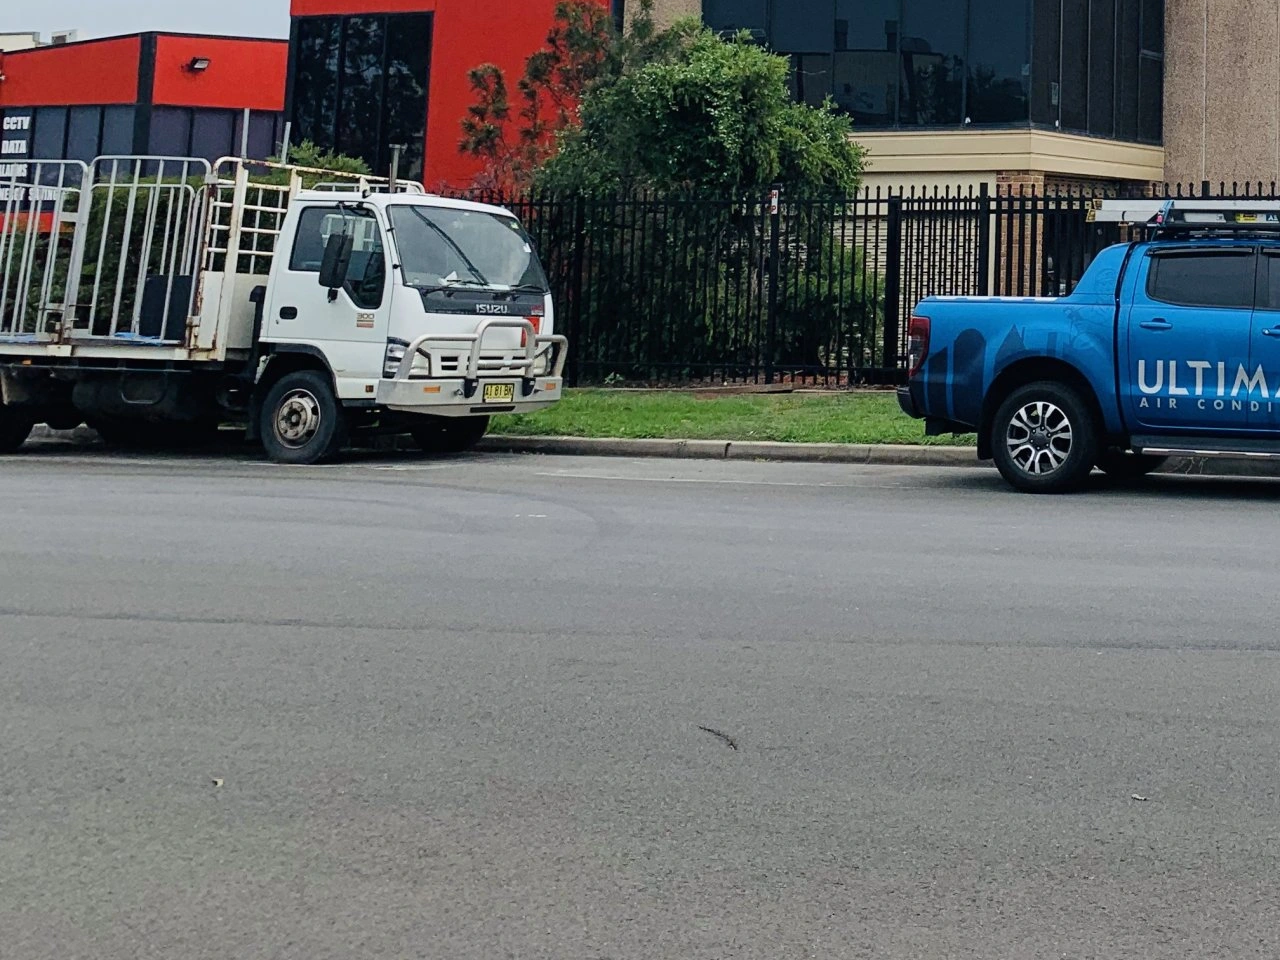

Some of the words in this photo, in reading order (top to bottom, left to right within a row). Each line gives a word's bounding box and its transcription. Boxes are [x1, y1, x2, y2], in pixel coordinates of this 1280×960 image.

[2, 116, 31, 130] CCTV
[1, 140, 27, 154] DATA
[475, 304, 508, 314] ISUZU
[1139, 397, 1177, 409] AIR
